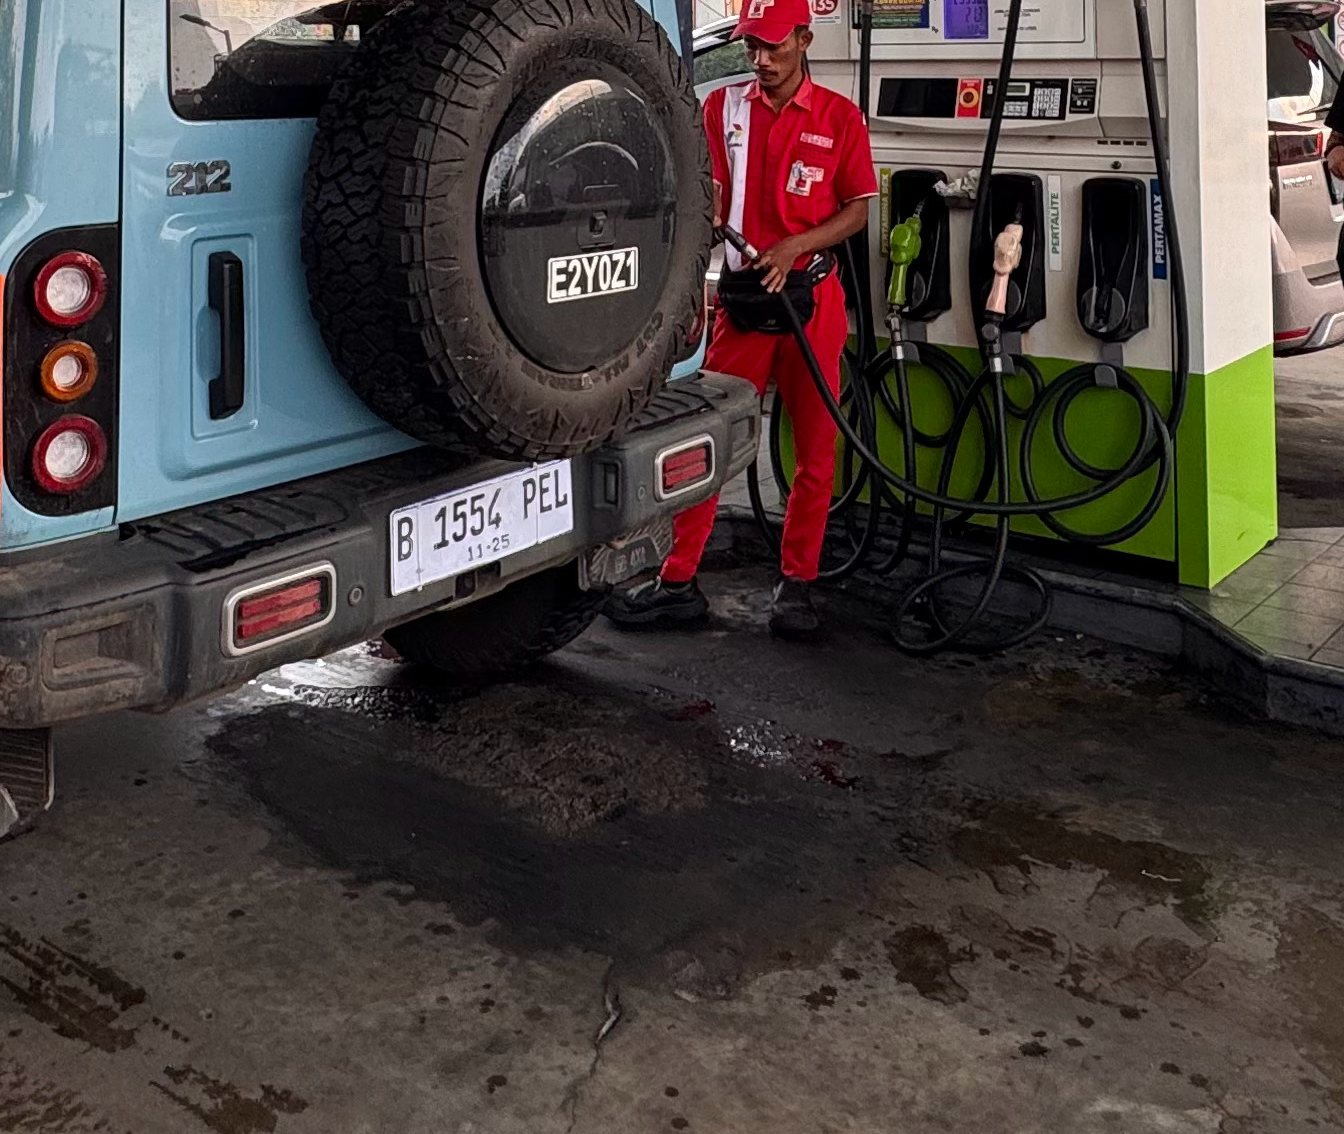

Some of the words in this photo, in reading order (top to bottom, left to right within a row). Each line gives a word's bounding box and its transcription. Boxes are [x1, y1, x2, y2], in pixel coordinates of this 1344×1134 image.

[166, 159, 232, 197] 212
[1049, 190, 1061, 256] PERTALITE
[1152, 192, 1168, 265] PERTAMAX
[396, 515, 414, 563] B
[432, 487, 503, 551] 1554
[522, 468, 569, 521] PEL
